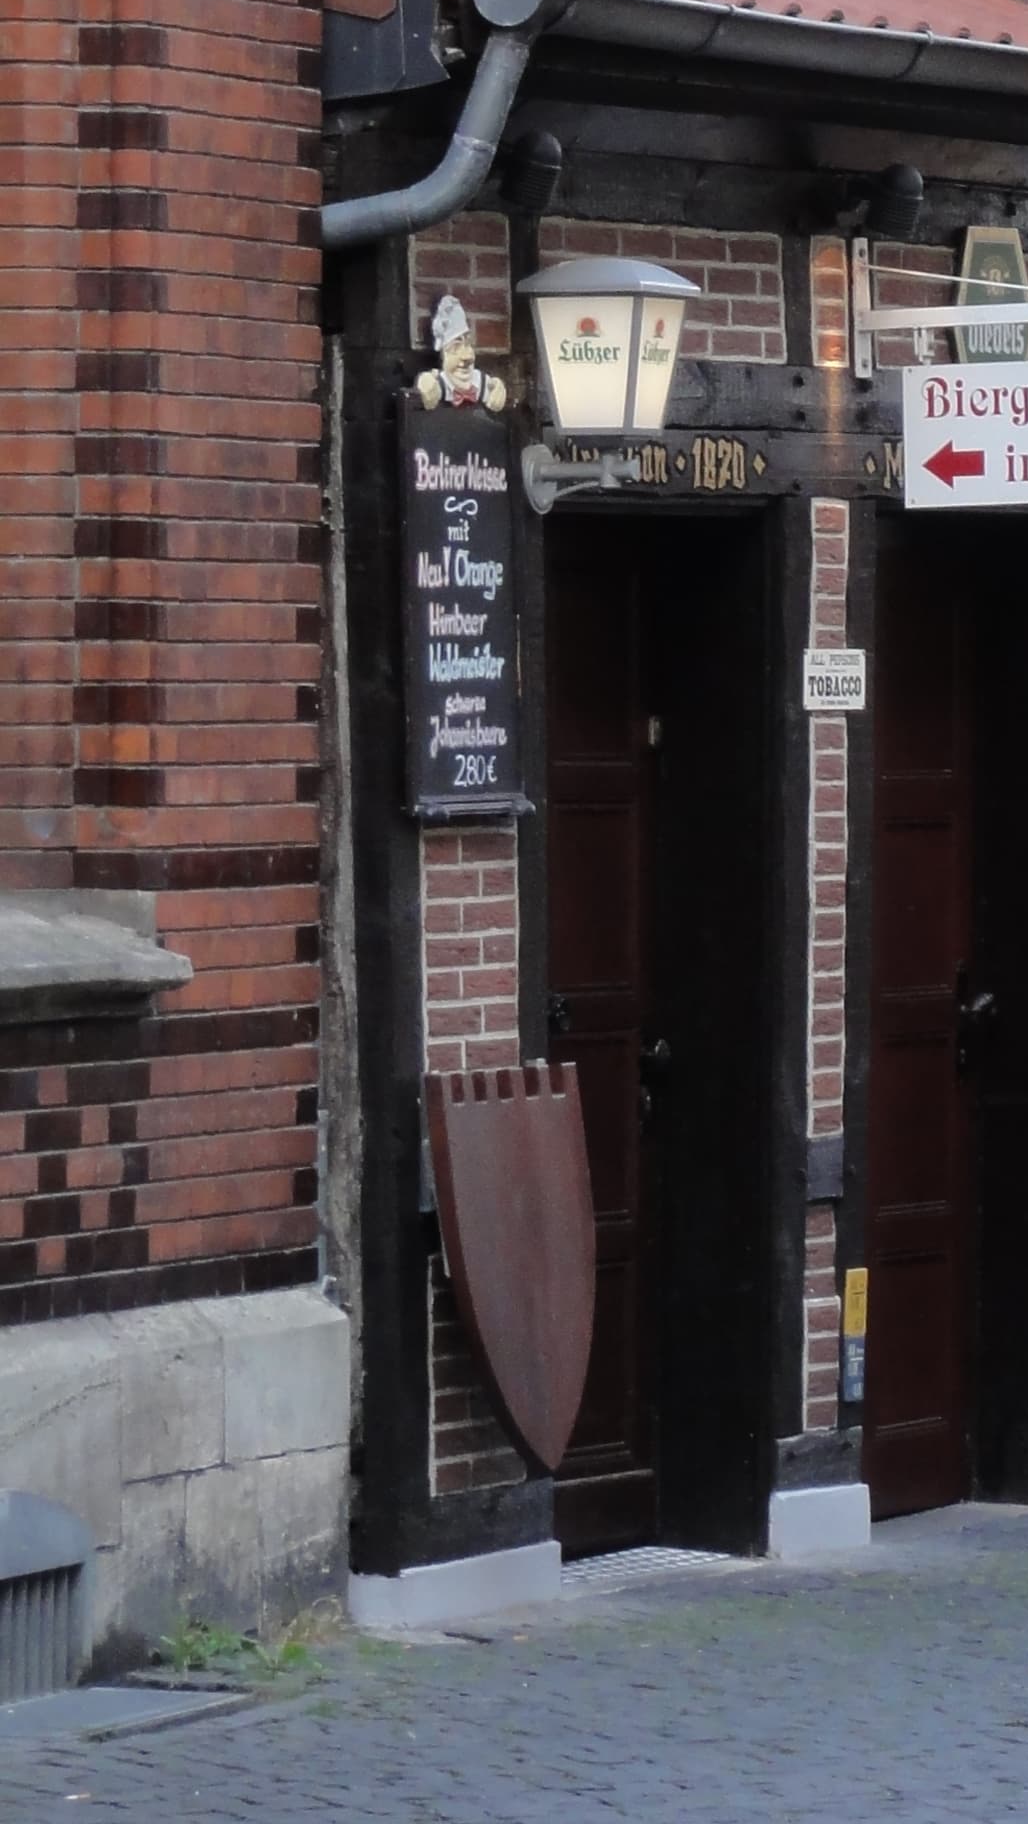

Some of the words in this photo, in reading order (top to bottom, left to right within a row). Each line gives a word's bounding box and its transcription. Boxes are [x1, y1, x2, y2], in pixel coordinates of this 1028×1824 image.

[558, 338, 621, 365] Lübzer
[414, 448, 467, 492] Berliner
[692, 437, 746, 490] 1870
[448, 518, 470, 542] mit
[454, 548, 504, 601] Orange
[429, 601, 488, 637] Himbeer
[429, 642, 505, 682] Waldmeister
[808, 675, 862, 697] TOBACCO
